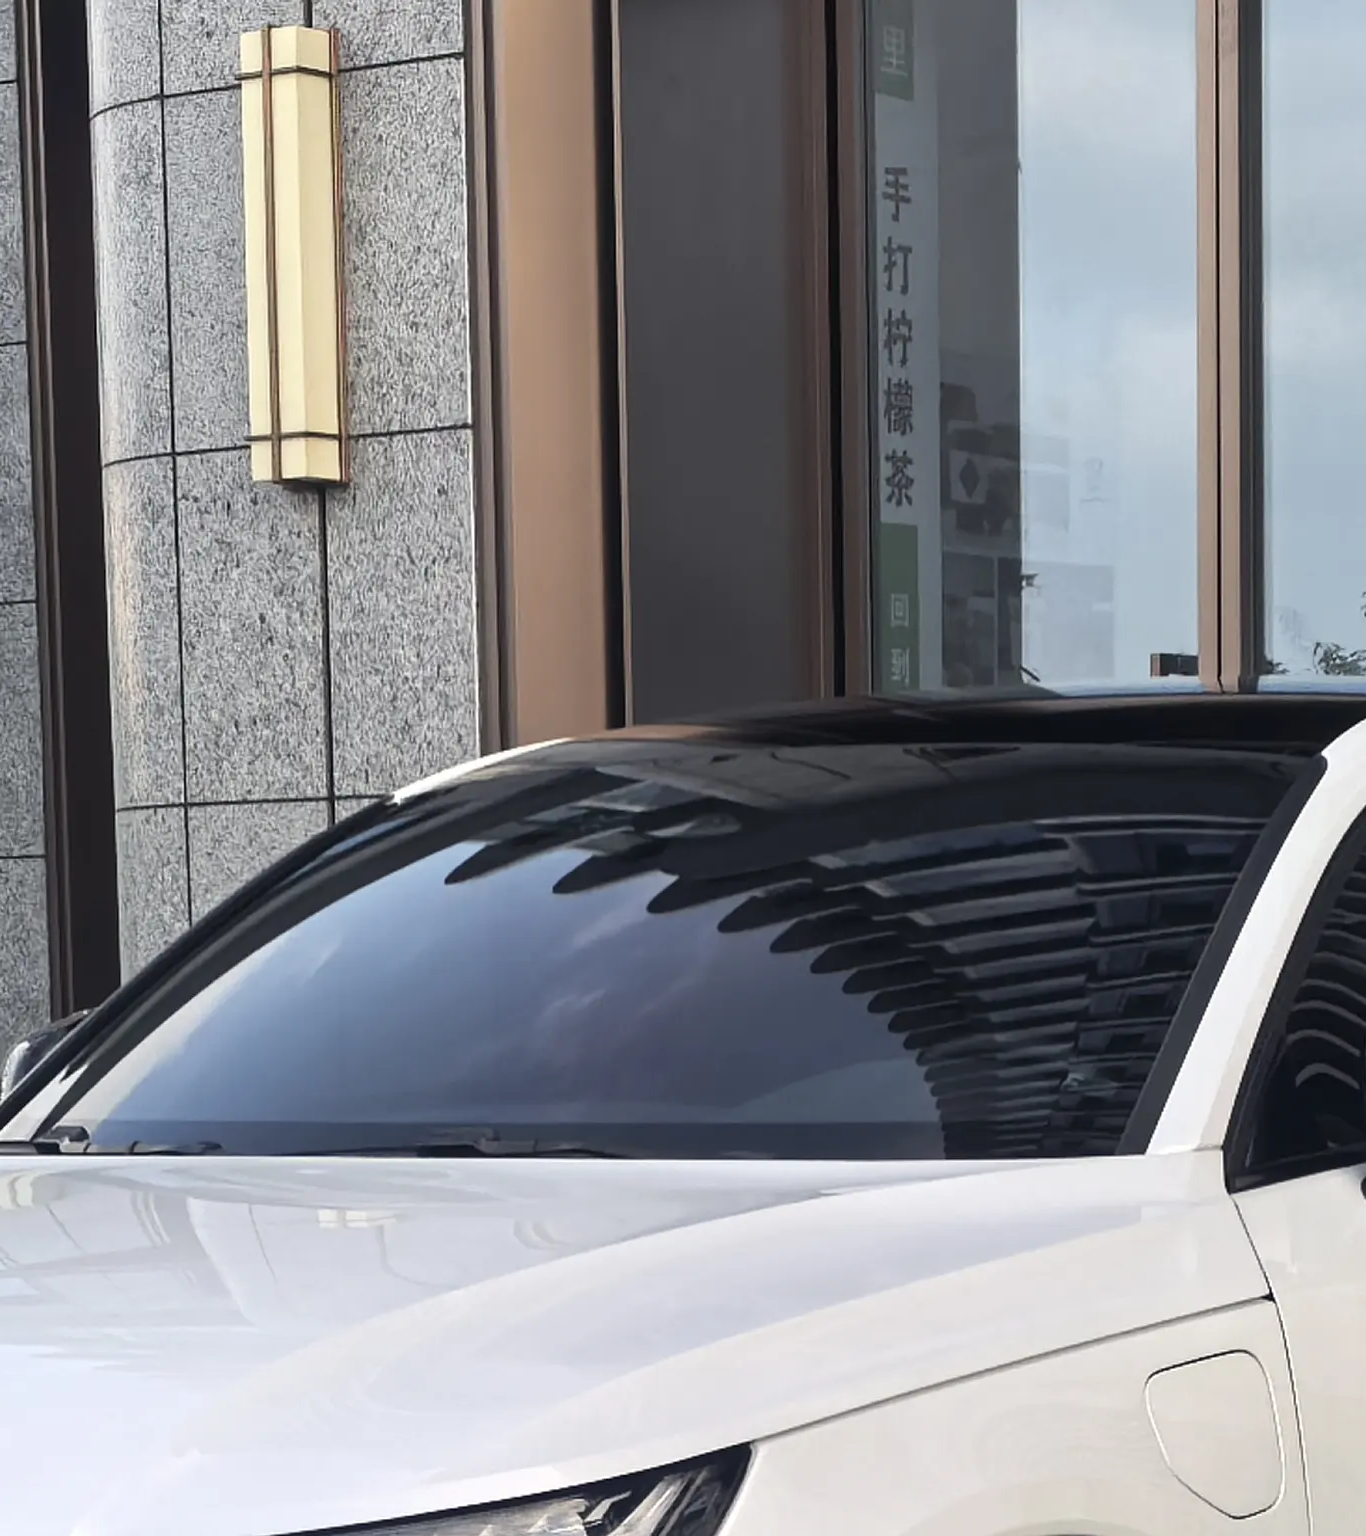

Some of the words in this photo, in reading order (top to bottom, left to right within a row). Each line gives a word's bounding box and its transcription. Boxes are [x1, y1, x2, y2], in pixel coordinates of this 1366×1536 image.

[882, 166, 915, 508] 手打柠檬茶
